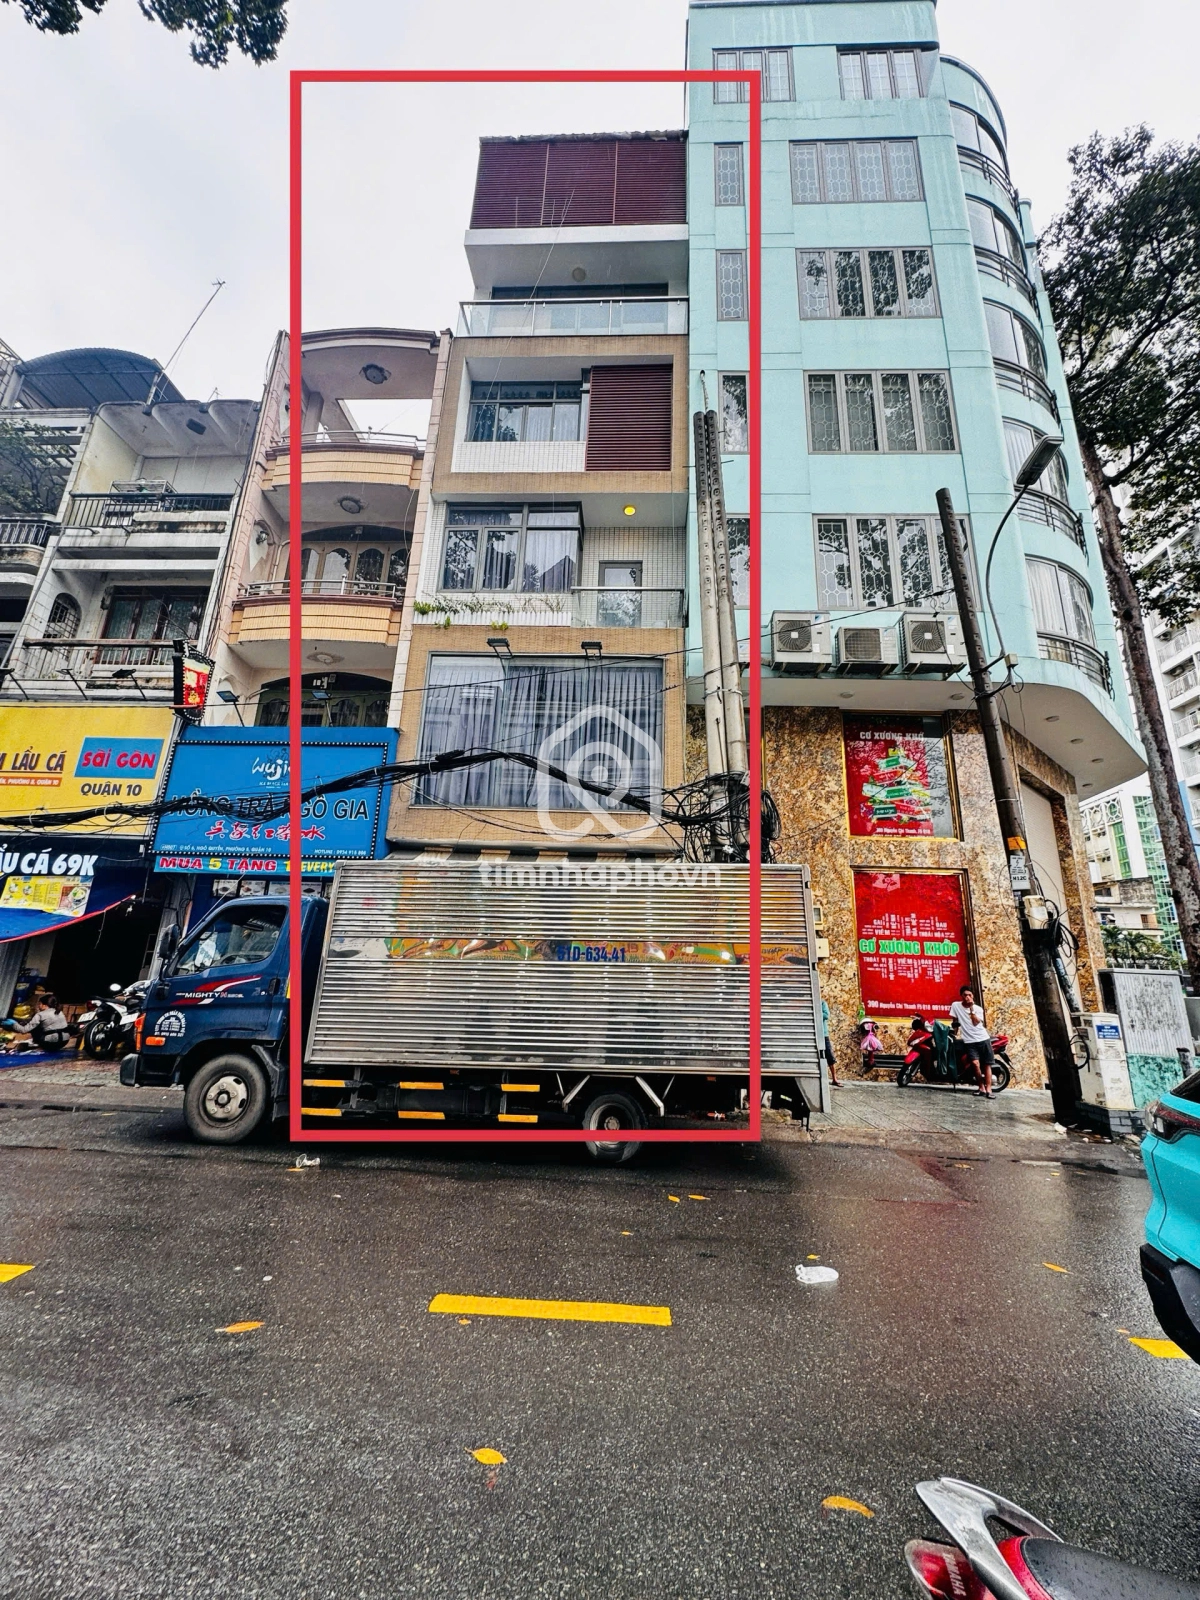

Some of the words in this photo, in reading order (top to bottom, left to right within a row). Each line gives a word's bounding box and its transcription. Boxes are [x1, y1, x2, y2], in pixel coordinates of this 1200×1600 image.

[11, 746, 40, 771] LẨU
[46, 750, 67, 771] CÁ
[80, 781, 122, 797] QUẬN
[126, 784, 142, 796] 10
[333, 798, 369, 820] GIA
[20, 848, 52, 874] CÁ
[52, 854, 98, 876] 69K
[159, 857, 203, 870] MUA
[209, 858, 222, 870] 5
[227, 858, 277, 873] TẶNG
[859, 937, 876, 953] CƠ
[879, 937, 920, 955] XƯƠNG
[924, 938, 959, 957] KHỚP
[942, 1553, 966, 1596] YAMAHA
